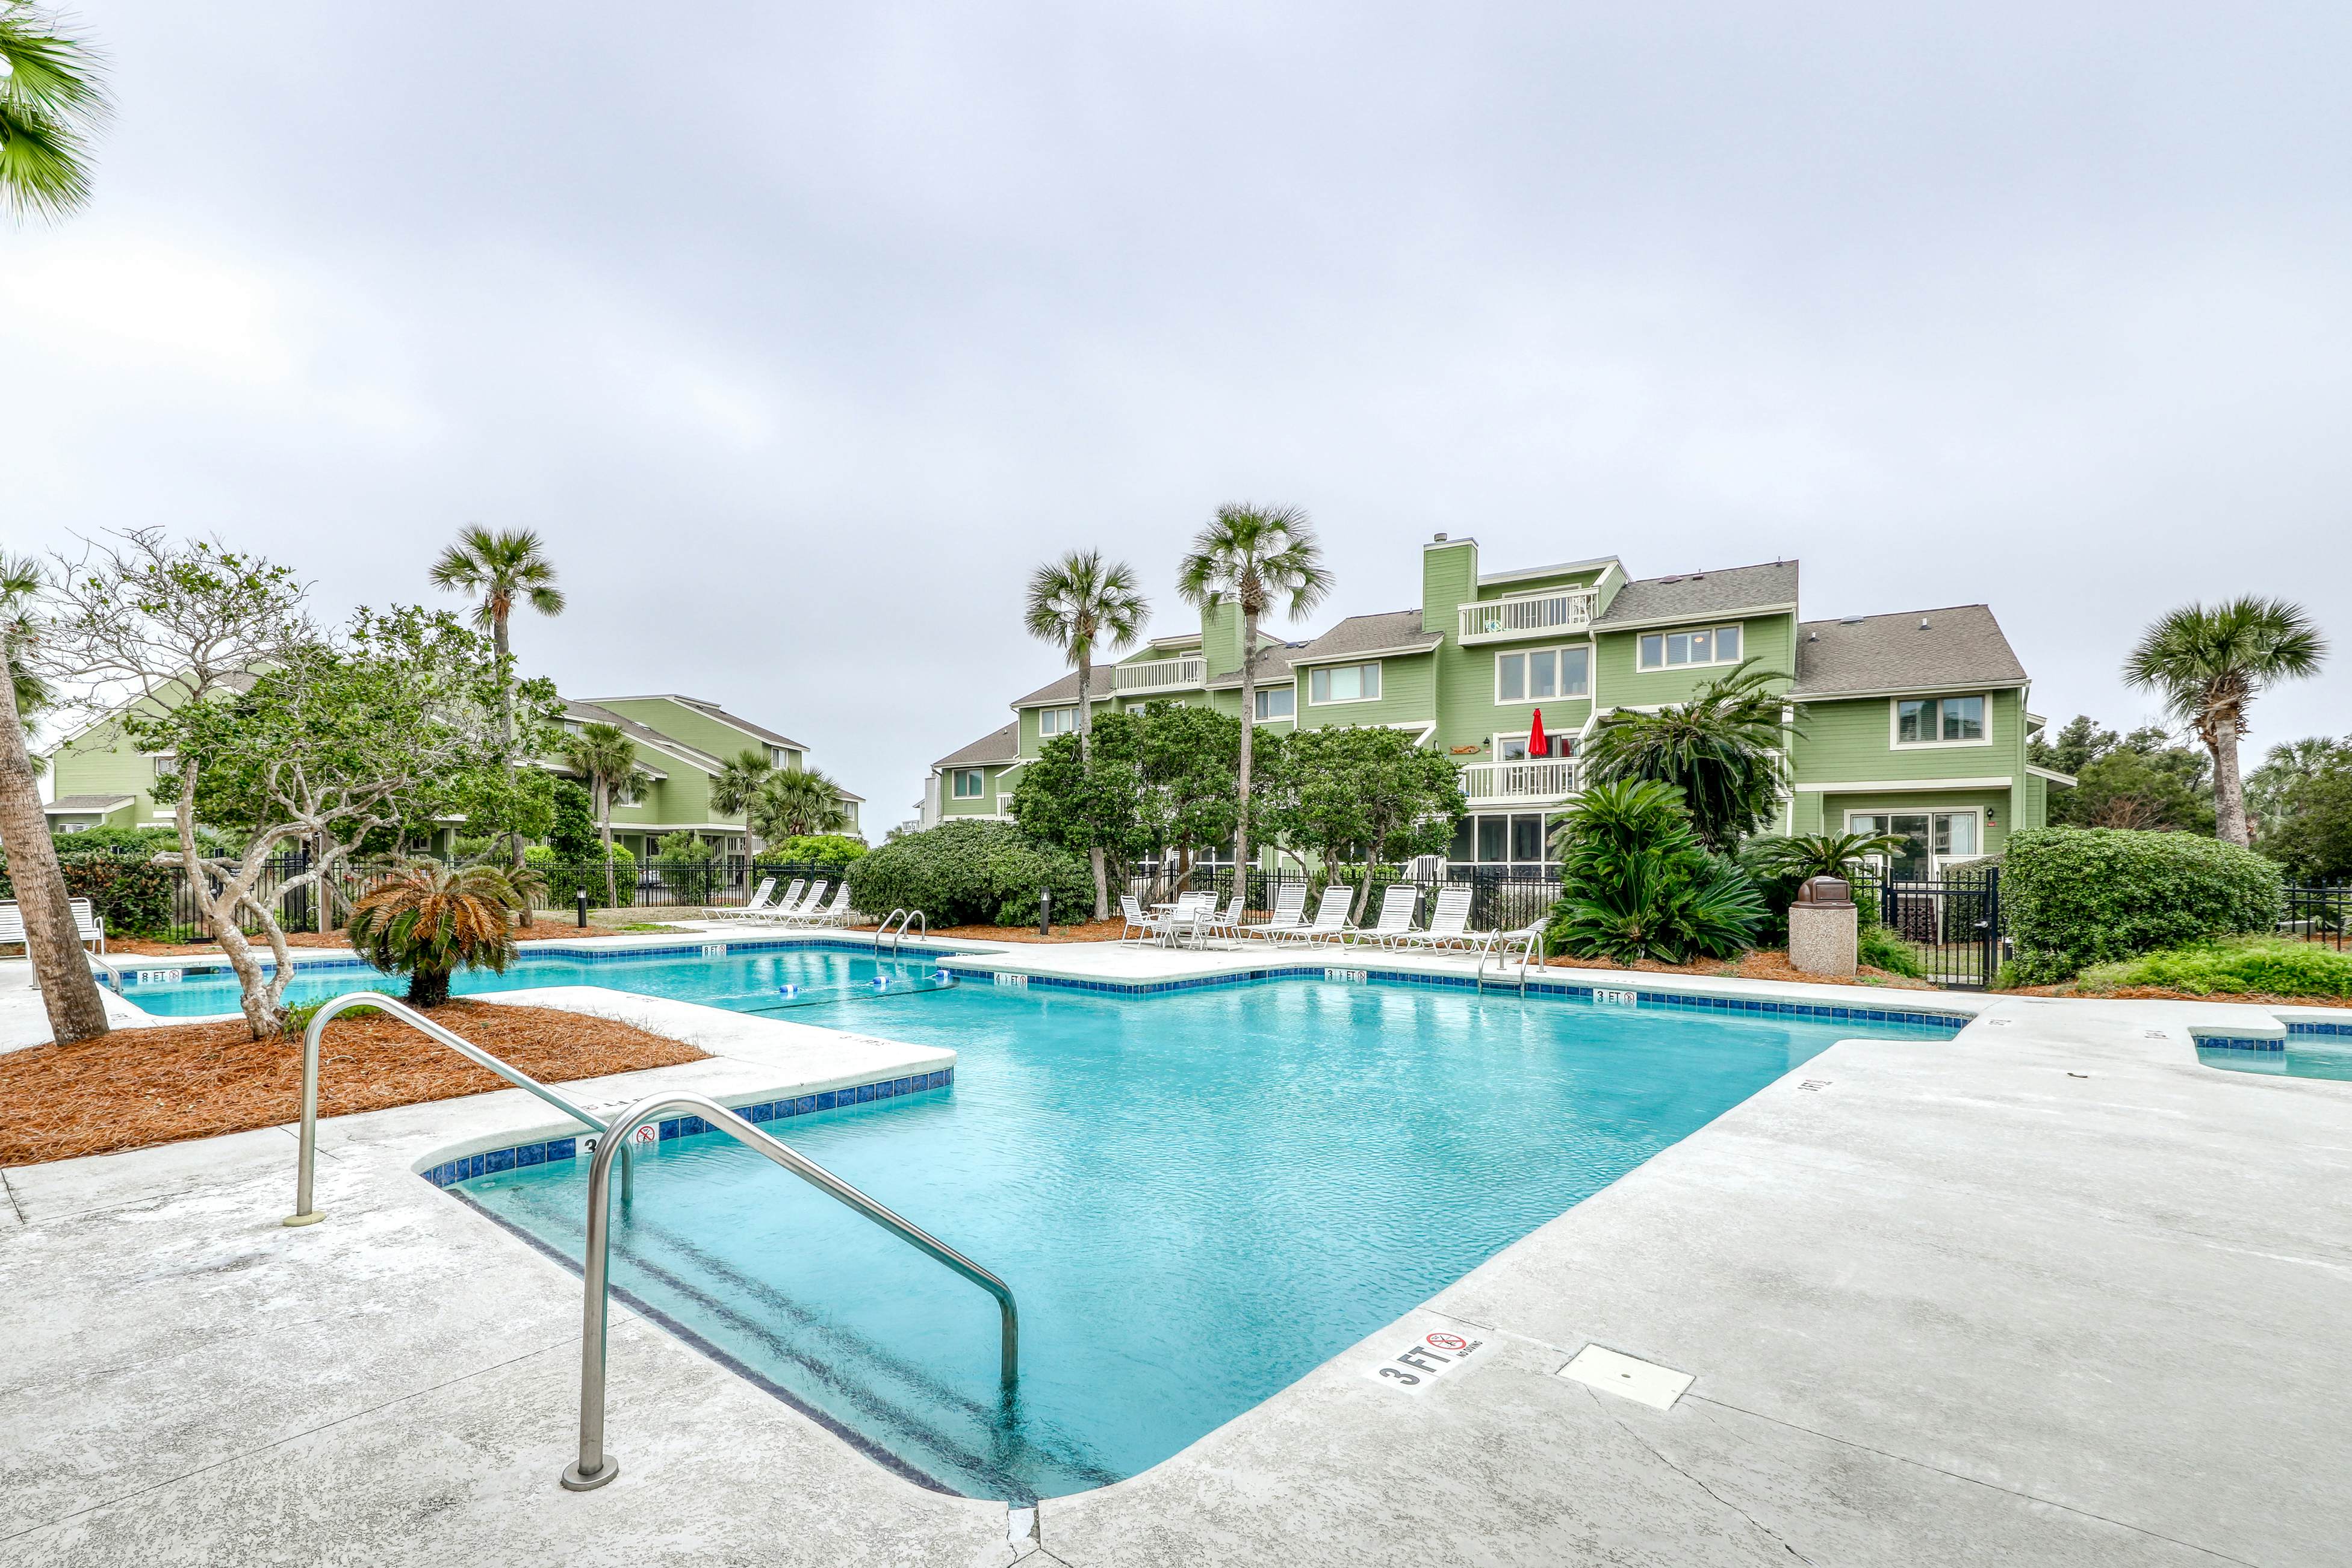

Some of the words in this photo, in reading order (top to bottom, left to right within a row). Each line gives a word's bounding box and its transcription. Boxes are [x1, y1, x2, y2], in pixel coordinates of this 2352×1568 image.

[1597, 991, 1604, 1000] 3
[584, 1138, 597, 1154] 3
[1463, 1340, 1483, 1353] DIVING
[1397, 1346, 1451, 1373] FT
[1379, 1368, 1420, 1385] 3
